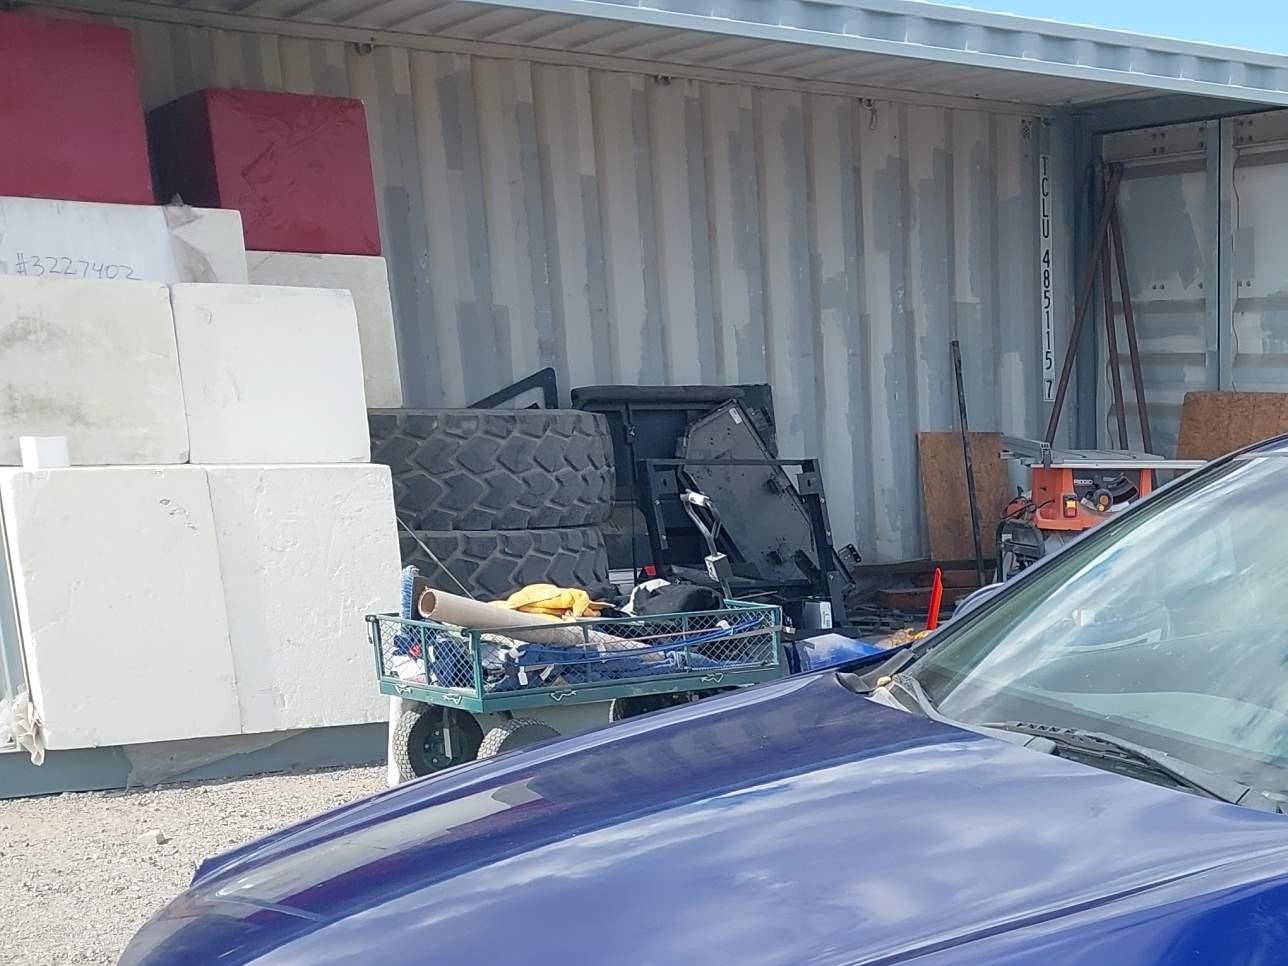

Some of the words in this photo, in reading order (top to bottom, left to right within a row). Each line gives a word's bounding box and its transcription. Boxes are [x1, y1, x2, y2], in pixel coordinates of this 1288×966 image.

[1041, 156, 1050, 238] TCLU
[16, 252, 142, 281] #3227402
[1042, 249, 1052, 370] 485115
[1045, 380, 1053, 399] 7
